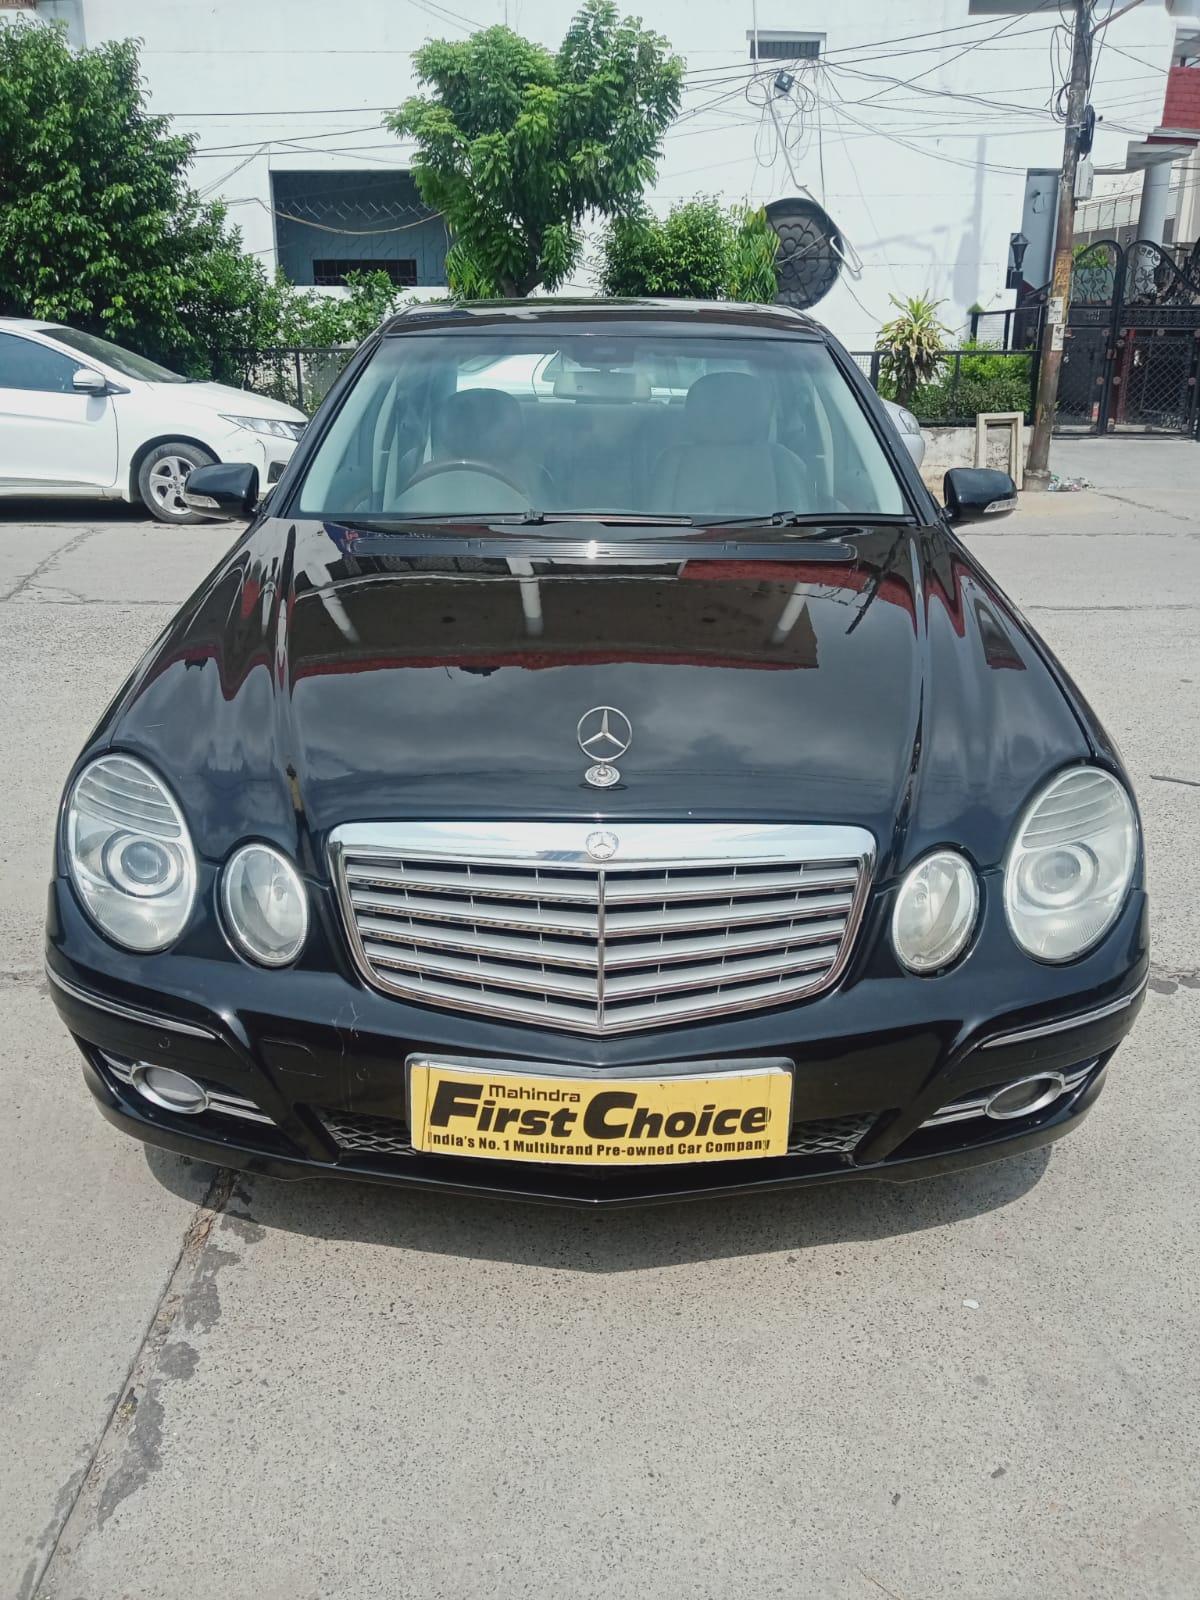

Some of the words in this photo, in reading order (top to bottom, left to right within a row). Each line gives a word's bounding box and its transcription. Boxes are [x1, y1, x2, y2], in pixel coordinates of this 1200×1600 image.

[489, 1084, 581, 1103] Mahindra
[430, 1080, 578, 1138] First
[583, 1091, 772, 1140] Choice
[427, 1131, 475, 1148] India's
[479, 1137, 500, 1151] No.
[503, 1139, 510, 1151] 1
[513, 1140, 593, 1156] Multibrand
[597, 1143, 674, 1157] Pre-owned
[678, 1143, 702, 1155] Car
[705, 1139, 770, 1154] Company
